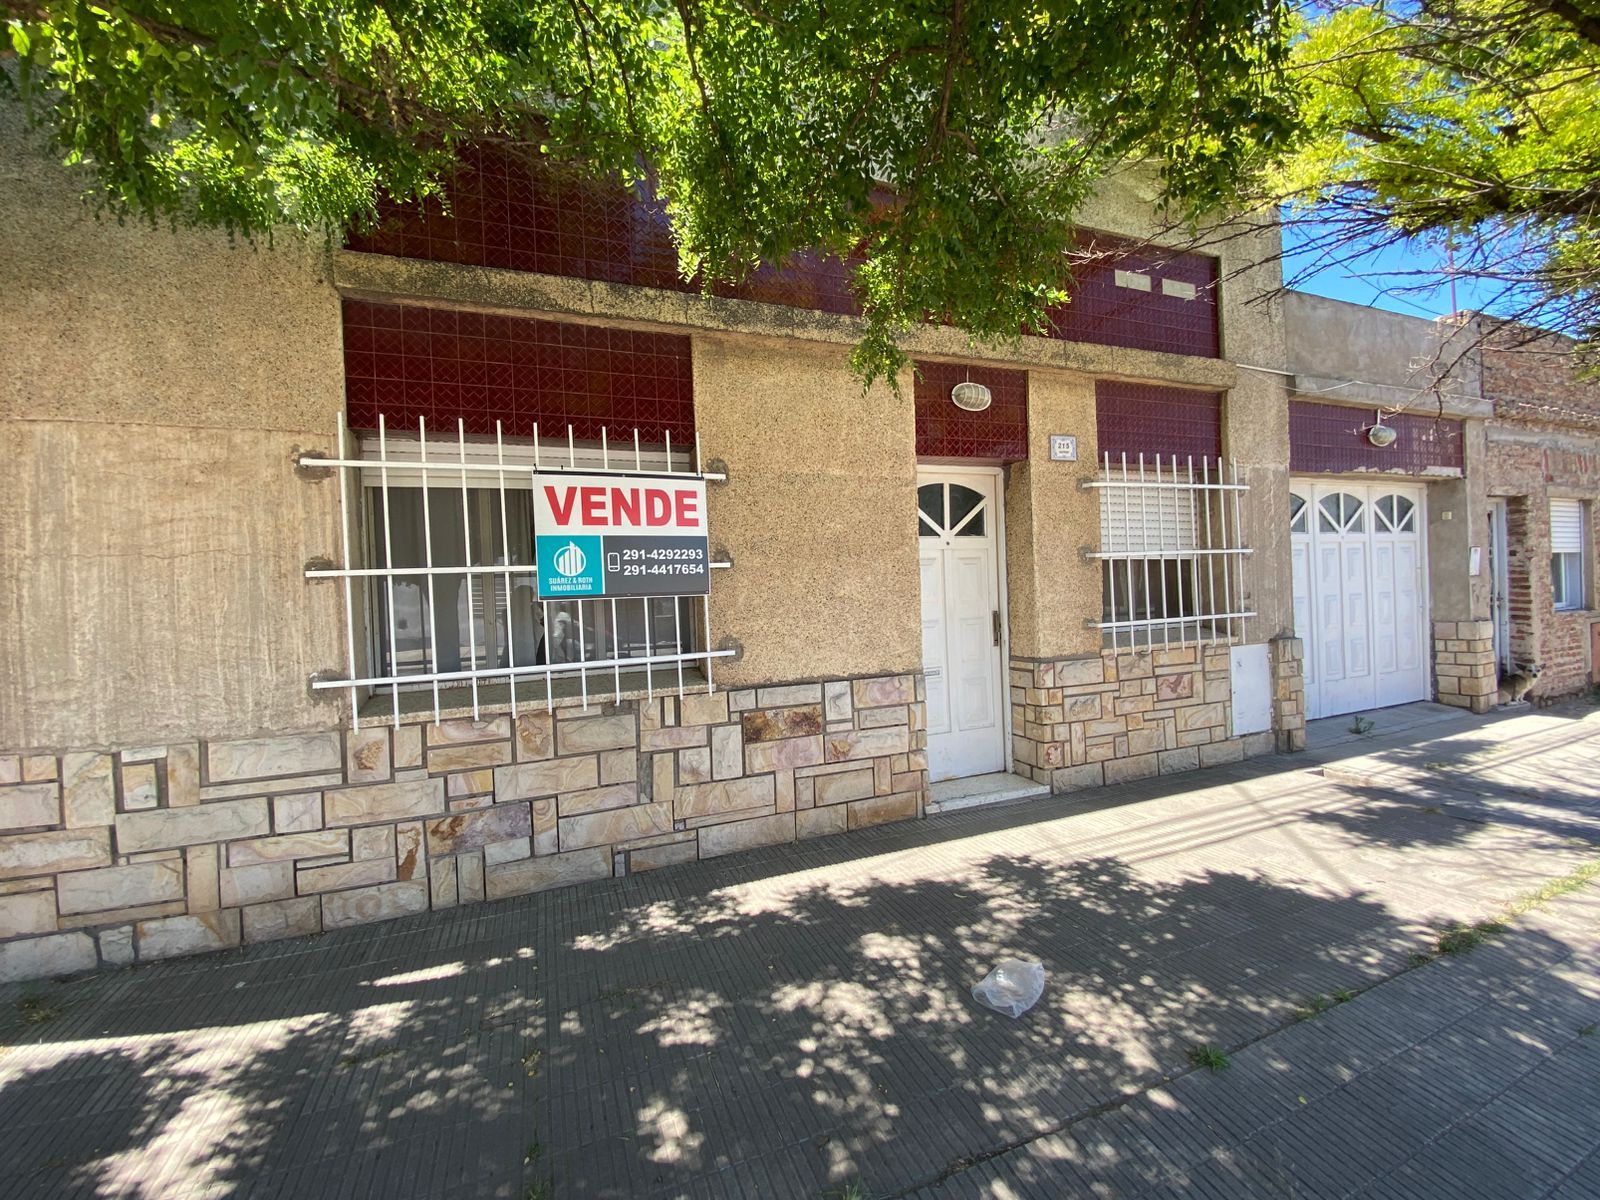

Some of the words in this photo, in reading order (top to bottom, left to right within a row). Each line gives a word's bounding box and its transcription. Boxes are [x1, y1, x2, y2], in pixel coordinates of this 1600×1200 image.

[544, 486, 699, 527] VENDE
[623, 549, 703, 560] 291-4292293
[623, 564, 704, 576] 291-4417654
